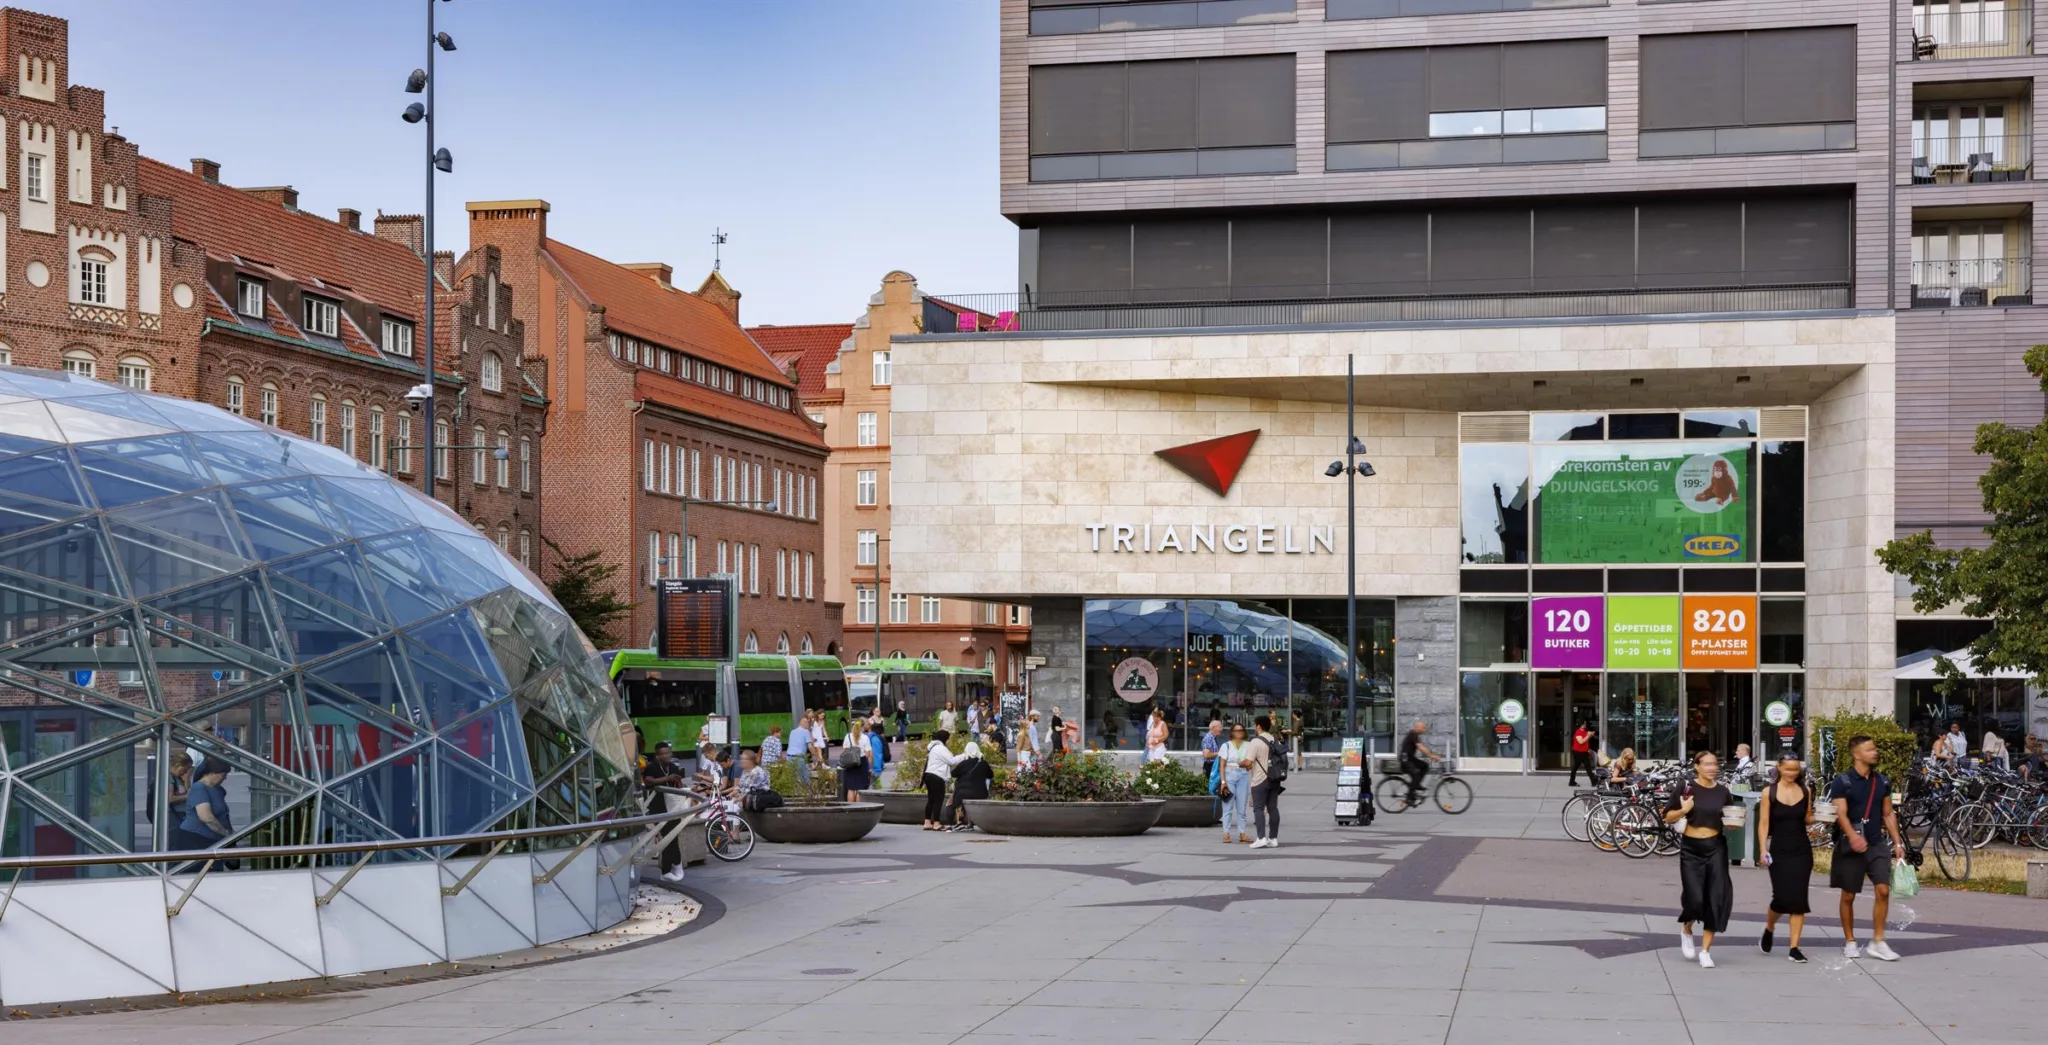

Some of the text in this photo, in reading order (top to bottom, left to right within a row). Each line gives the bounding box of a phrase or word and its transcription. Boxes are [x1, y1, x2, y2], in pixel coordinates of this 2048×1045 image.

[1653, 461, 1672, 473] av
[1550, 479, 1660, 494] DJUNGELSKOG
[1085, 523, 1335, 554] TRIANGELN
[1689, 541, 1736, 551] IKEA
[1544, 609, 1591, 632] 120
[1693, 609, 1747, 633] 820
[1613, 622, 1673, 633] ÖPPETTIDER
[1189, 634, 1213, 652] JOE
[1224, 634, 1248, 652] THE
[1252, 634, 1290, 652] JUICE
[1544, 638, 1590, 649] BUTIKER
[1691, 638, 1748, 649] P-PLATSER
